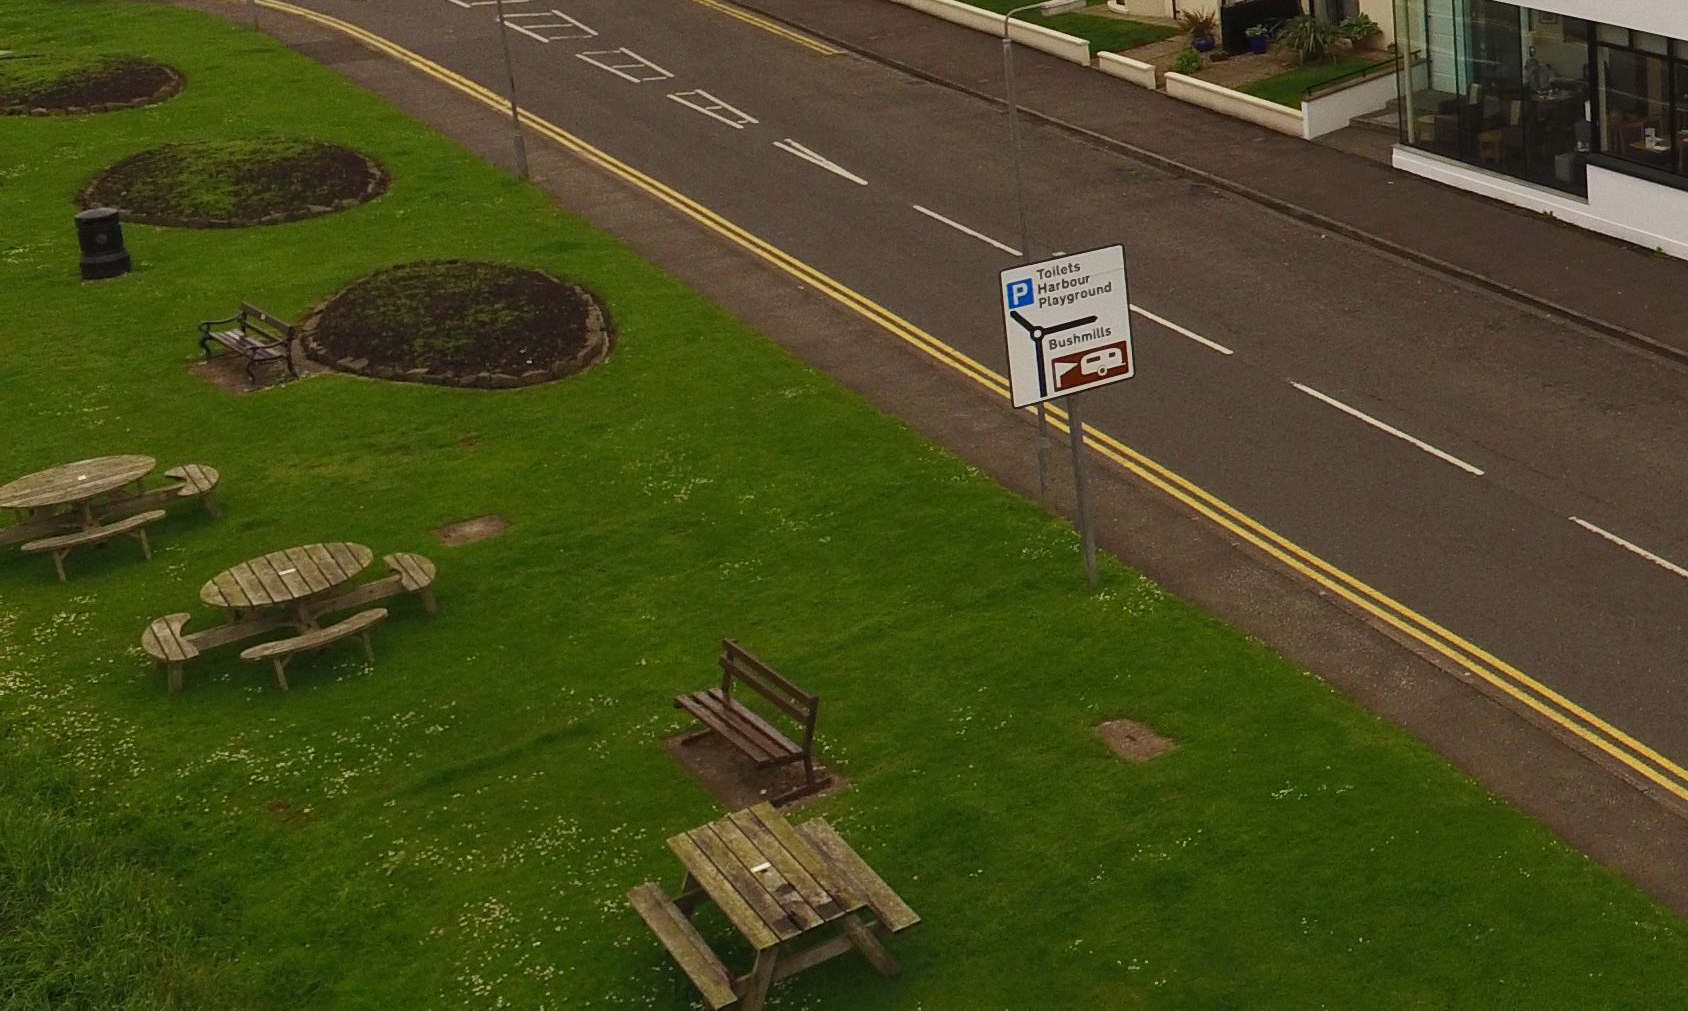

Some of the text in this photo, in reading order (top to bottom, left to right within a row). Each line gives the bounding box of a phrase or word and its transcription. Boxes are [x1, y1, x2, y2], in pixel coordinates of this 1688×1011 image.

[1036, 262, 1081, 280] Toilets
[1037, 275, 1090, 295] Harbour
[1039, 281, 1112, 308] Playground
[1049, 327, 1112, 350] Bushmills
